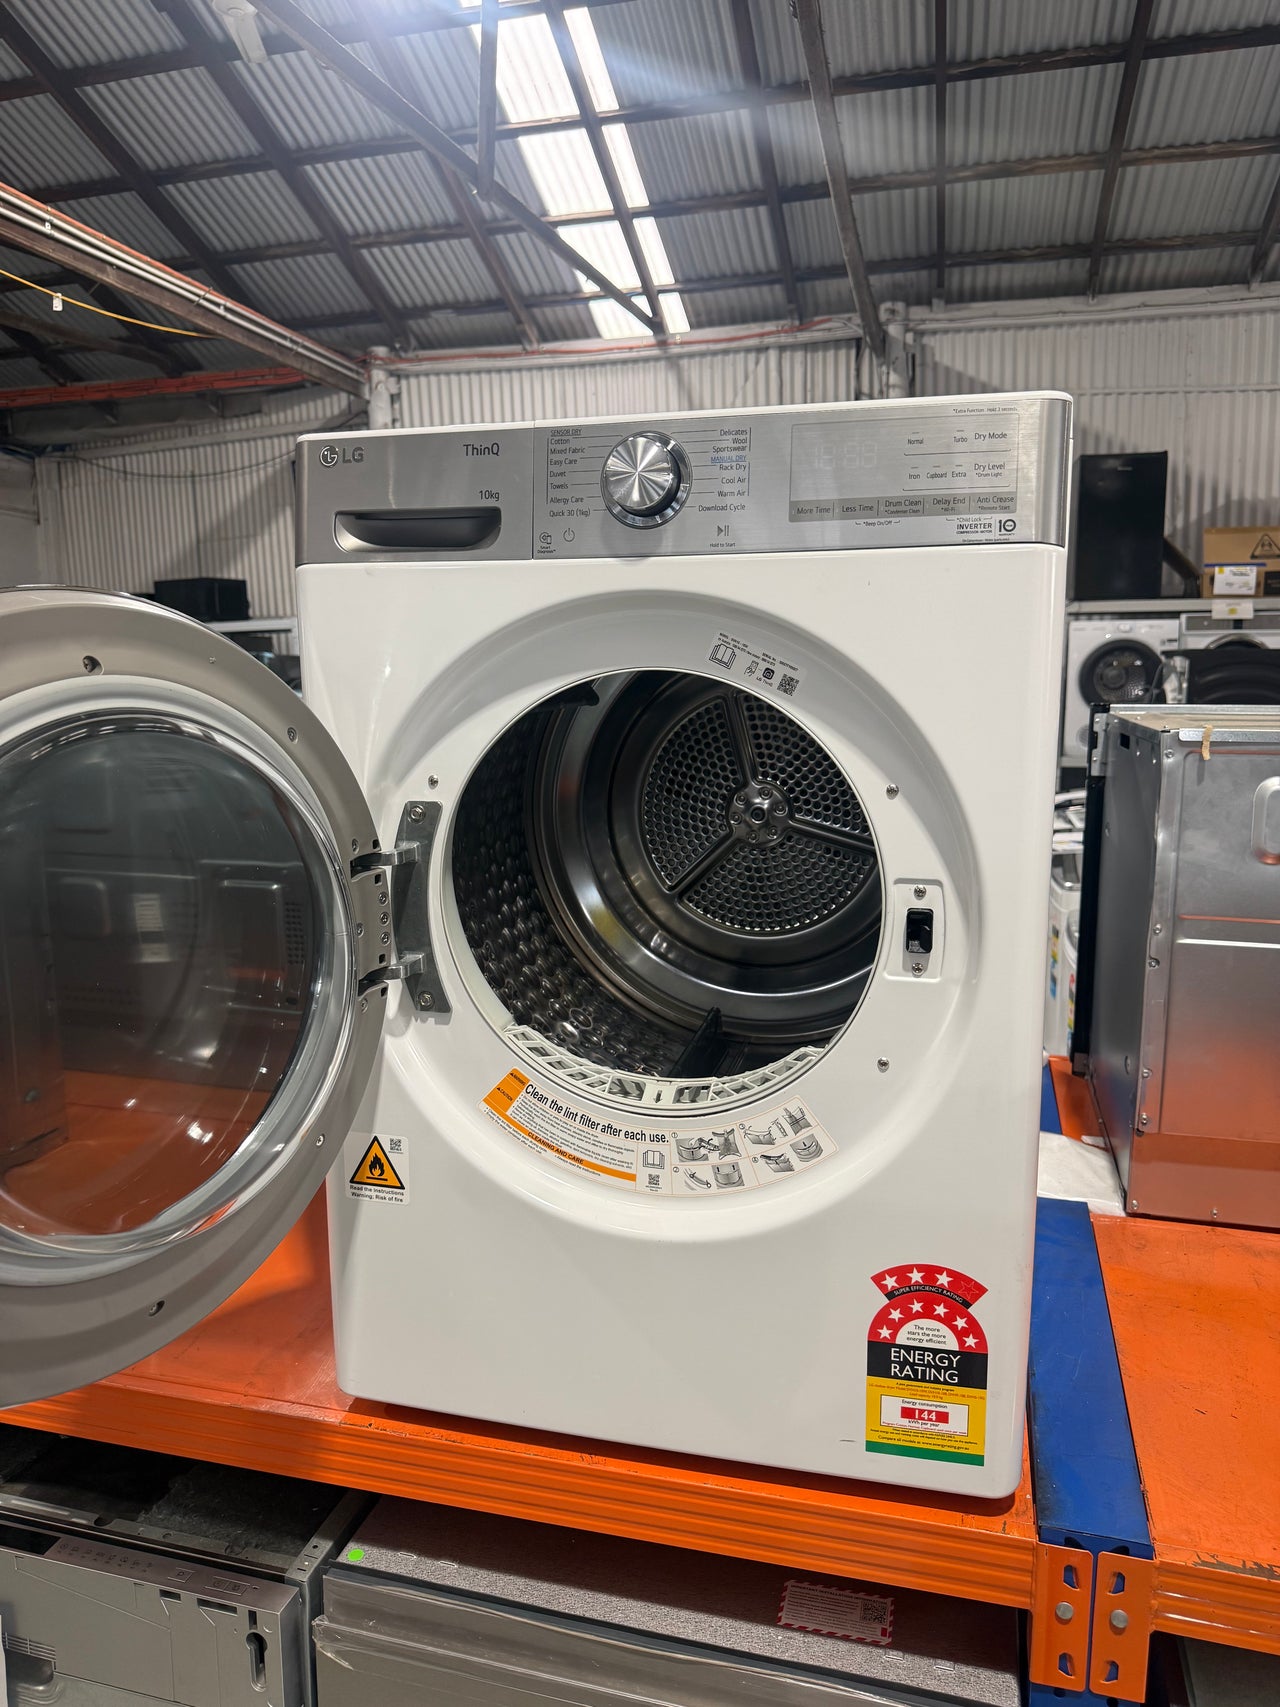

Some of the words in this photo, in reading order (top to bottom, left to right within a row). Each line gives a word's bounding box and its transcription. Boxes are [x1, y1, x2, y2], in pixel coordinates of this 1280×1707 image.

[551, 429, 571, 437] SENSOR
[572, 428, 582, 436] DRY
[975, 432, 986, 441] Dry
[989, 431, 1007, 439] Mode
[463, 442, 500, 456] ThinQ
[712, 445, 747, 453] Sportswear
[342, 446, 364, 464] LG
[974, 464, 986, 472] Dry
[988, 462, 1005, 470] Level
[479, 490, 500, 501] 10kg
[550, 497, 570, 505] Allergy
[932, 498, 950, 506] Delay
[576, 508, 590, 517] (1kg)
[729, 504, 746, 512] Cycle
[816, 506, 831, 514] Time
[999, 519, 1016, 532] 10
[525, 1084, 548, 1105] Clean
[549, 1098, 563, 1114] the
[563, 1106, 579, 1122] lint
[579, 1114, 600, 1130] filter
[601, 1123, 622, 1138] after
[624, 1129, 647, 1141] each
[649, 1134, 669, 1143] use.
[527, 1131, 555, 1151] CLEANING
[555, 1149, 567, 1157] AND
[568, 1153, 584, 1165] CARE
[374, 1188, 404, 1196] instructions
[894, 1287, 910, 1295] SUPER
[911, 1285, 942, 1295] EFFICIENCY
[943, 1290, 963, 1303] RATING
[891, 1348, 961, 1367] ENERGY
[891, 1364, 959, 1383] RATING
[918, 1401, 948, 1409] consumption
[915, 1410, 936, 1421] 144
